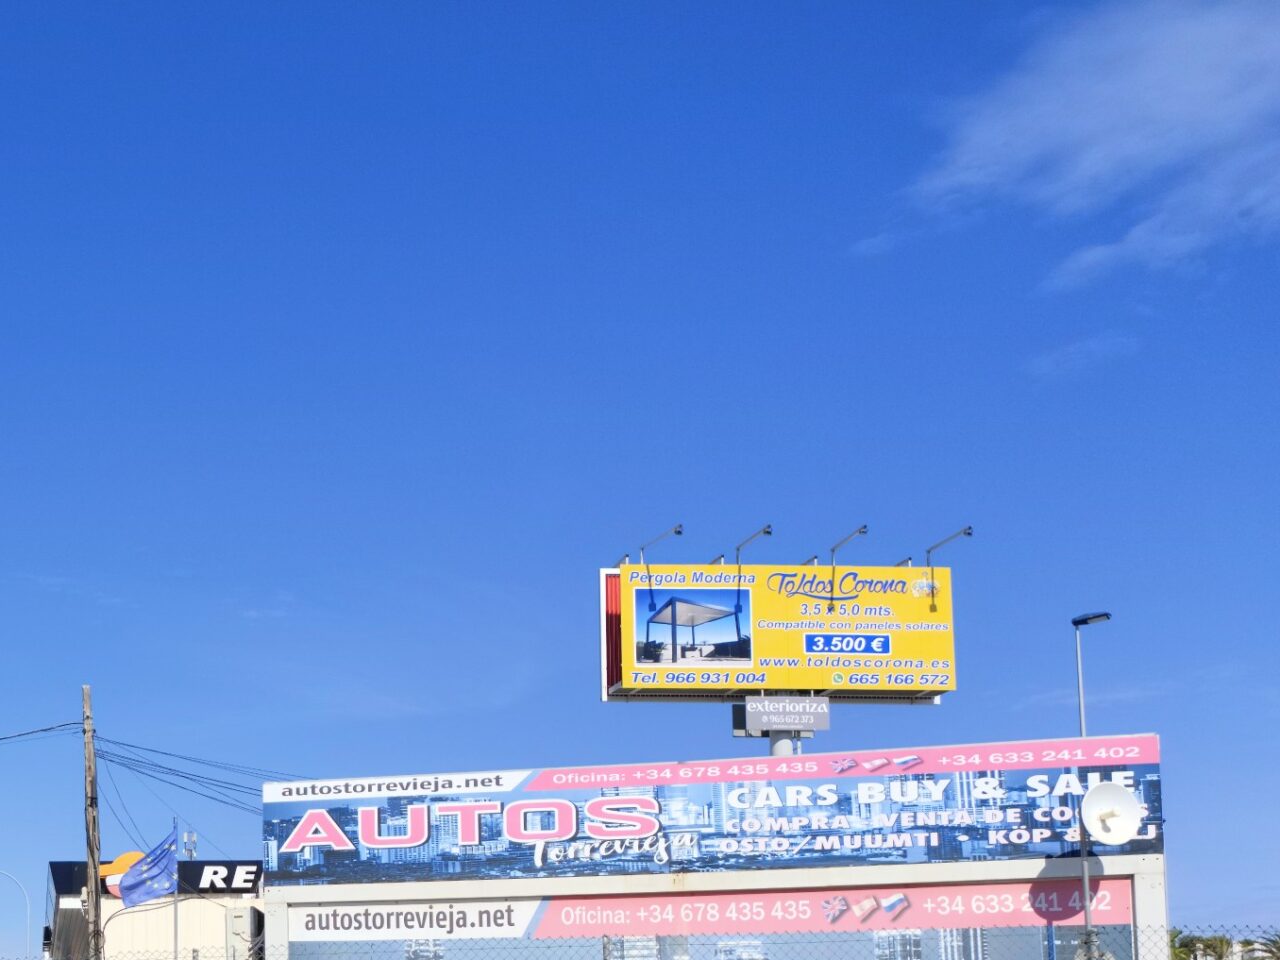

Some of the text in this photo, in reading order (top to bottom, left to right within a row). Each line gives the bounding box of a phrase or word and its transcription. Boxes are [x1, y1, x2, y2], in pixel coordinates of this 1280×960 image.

[691, 572, 756, 584] Moderna
[767, 572, 908, 599] Toldos Corona
[800, 604, 895, 616] 3,5 x 5,0 mts.
[757, 620, 826, 630] Compatible
[855, 621, 902, 631] paneles
[906, 622, 949, 631] solares
[812, 637, 886, 652] 3.500 €
[759, 656, 951, 669] www.toldoscorona.es
[631, 672, 767, 684] Tel. 966 931 004
[848, 673, 950, 685] 665 166 572
[746, 699, 829, 713] exterioriza
[938, 746, 1140, 766] +34 633 241 402
[552, 762, 819, 785] Oficina: +34 678 435 435
[281, 774, 504, 797] autostorrevieja.net
[727, 783, 839, 809] CARS
[857, 778, 952, 804] BUY
[972, 776, 1008, 800] &
[278, 796, 661, 853] AUTOS
[725, 814, 852, 833] COMPRA
[877, 809, 973, 828] VENTA
[985, 808, 1022, 824] DE
[988, 825, 1052, 846] KÖP
[526, 831, 697, 868] Torrevieja
[561, 900, 811, 925] Oficina: +34 678 435 435
[923, 895, 965, 916] +34
[971, 894, 1015, 914] 633
[1020, 892, 1063, 912] 241
[304, 904, 515, 933] autostorrevieja.net
